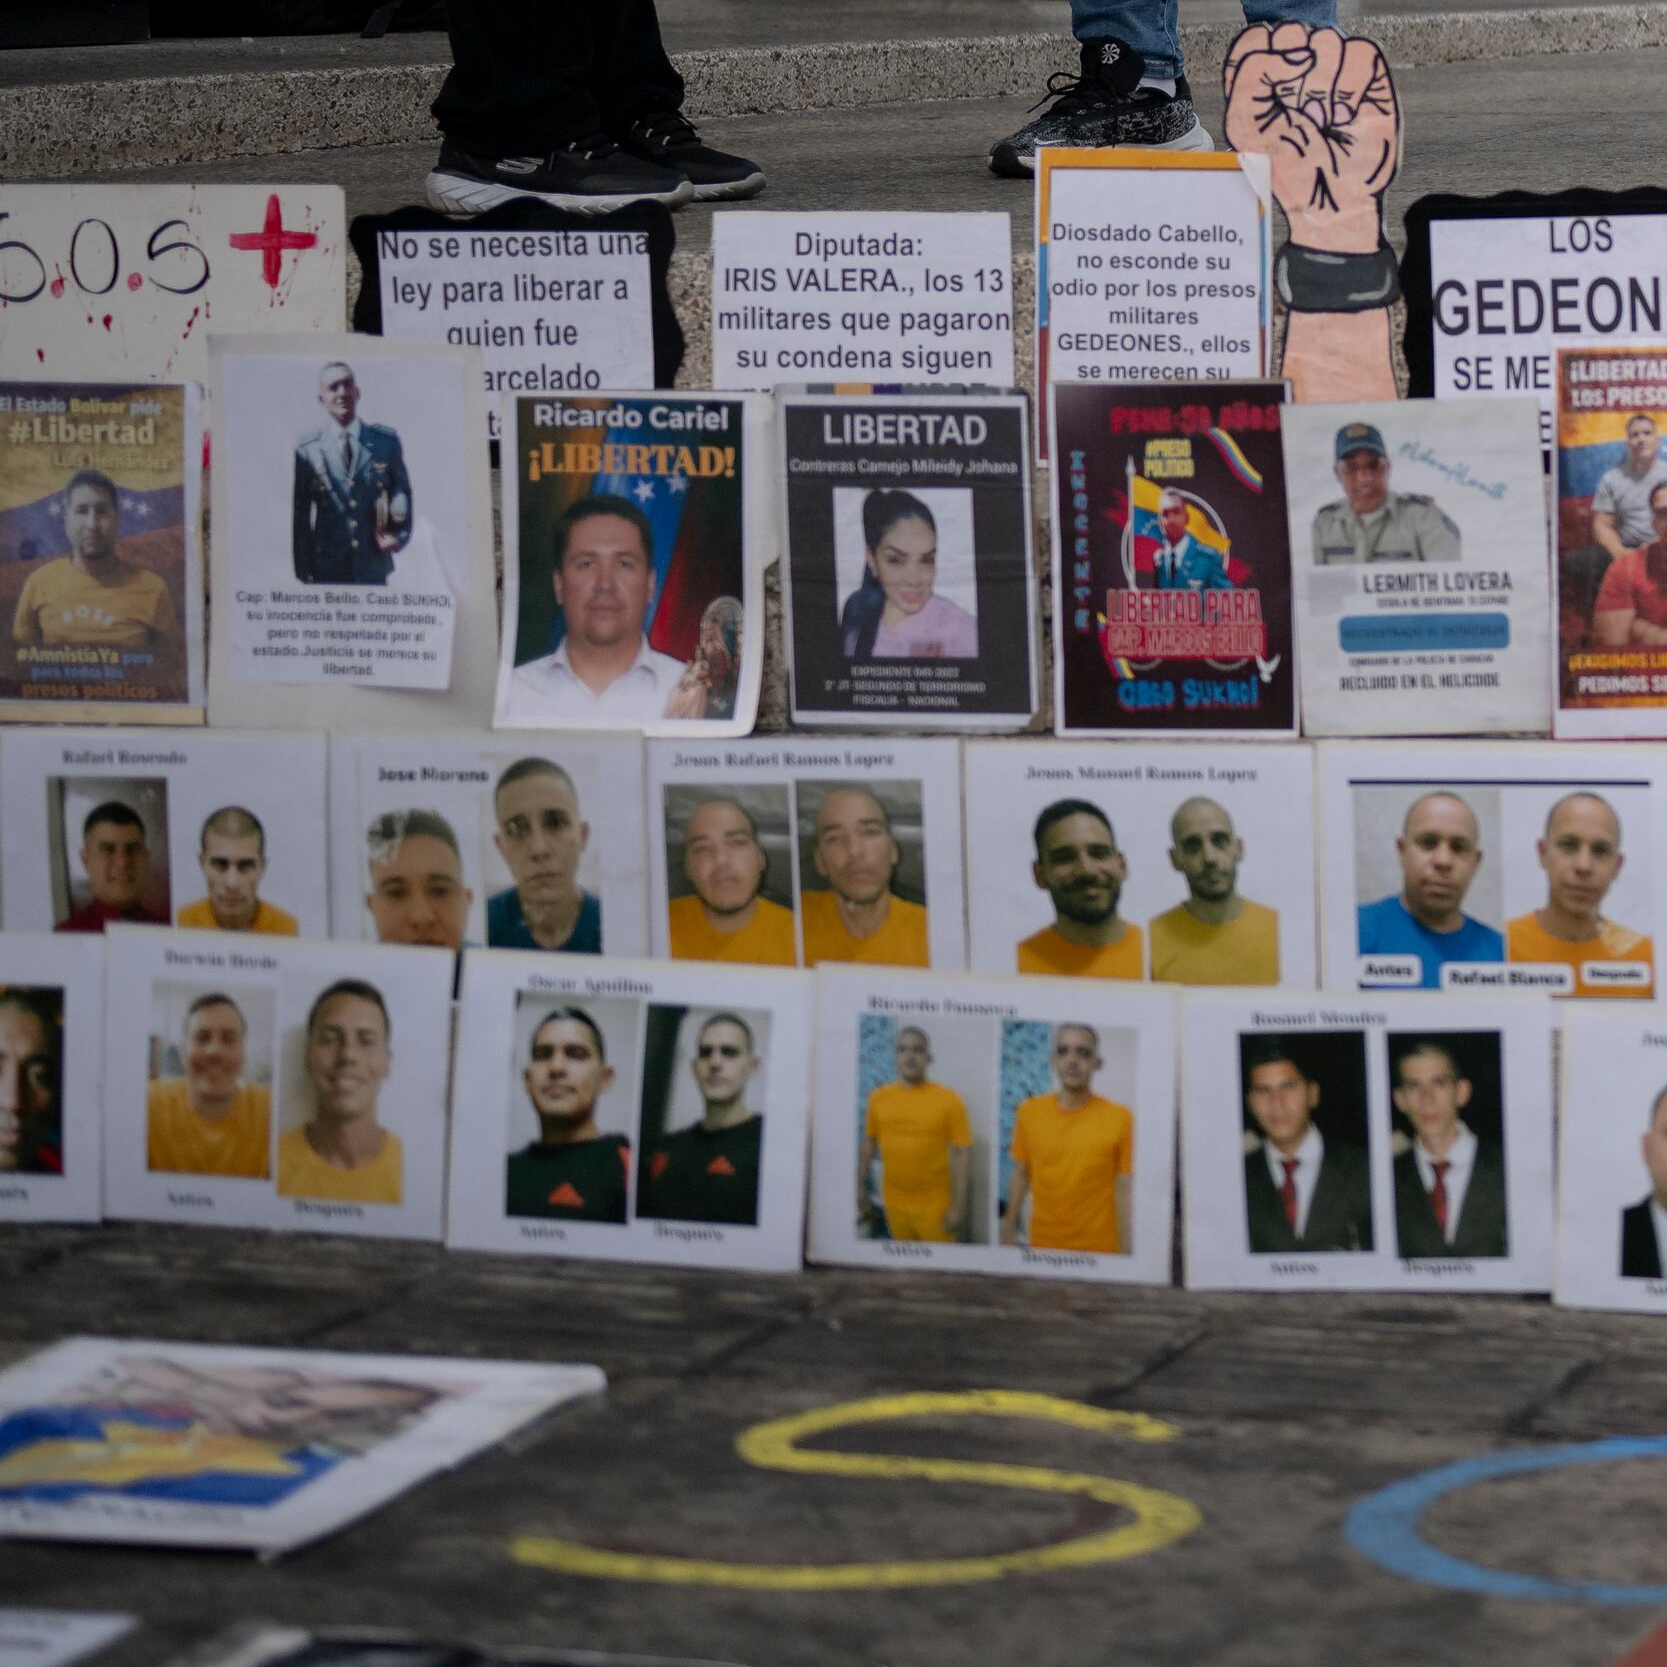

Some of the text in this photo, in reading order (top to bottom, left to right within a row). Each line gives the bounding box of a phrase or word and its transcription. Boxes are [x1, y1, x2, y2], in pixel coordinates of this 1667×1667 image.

[381, 232, 649, 259] No se necesita una
[795, 232, 923, 262] Diputada:
[1052, 223, 1244, 245] Diosdado Cabello,
[1549, 218, 1613, 253] LOS
[1078, 251, 1231, 271] no esconde su
[393, 273, 628, 310] ley para liberar a
[724, 268, 776, 292] IRIS
[925, 268, 963, 292] los
[974, 268, 1004, 292] 13
[1052, 278, 1256, 308] odio por los presos
[719, 306, 1010, 336] militares que pagaron
[1109, 305, 1199, 324] militares
[448, 318, 578, 346] quien fue
[1201, 334, 1250, 353] ellos
[737, 344, 992, 374] su condena siguen
[1078, 362, 1231, 380] se merecen su
[485, 362, 601, 391] arcelado
[1454, 356, 1493, 391] SE
[1572, 386, 1605, 408] LOS
[534, 403, 729, 430] Ricardo Cariel
[823, 413, 988, 445] LIBERTAD
[10, 417, 155, 445] #Libertad
[529, 443, 736, 482] ¡LIBERTAD!
[1362, 571, 1513, 594] LERMITH LOVERA
